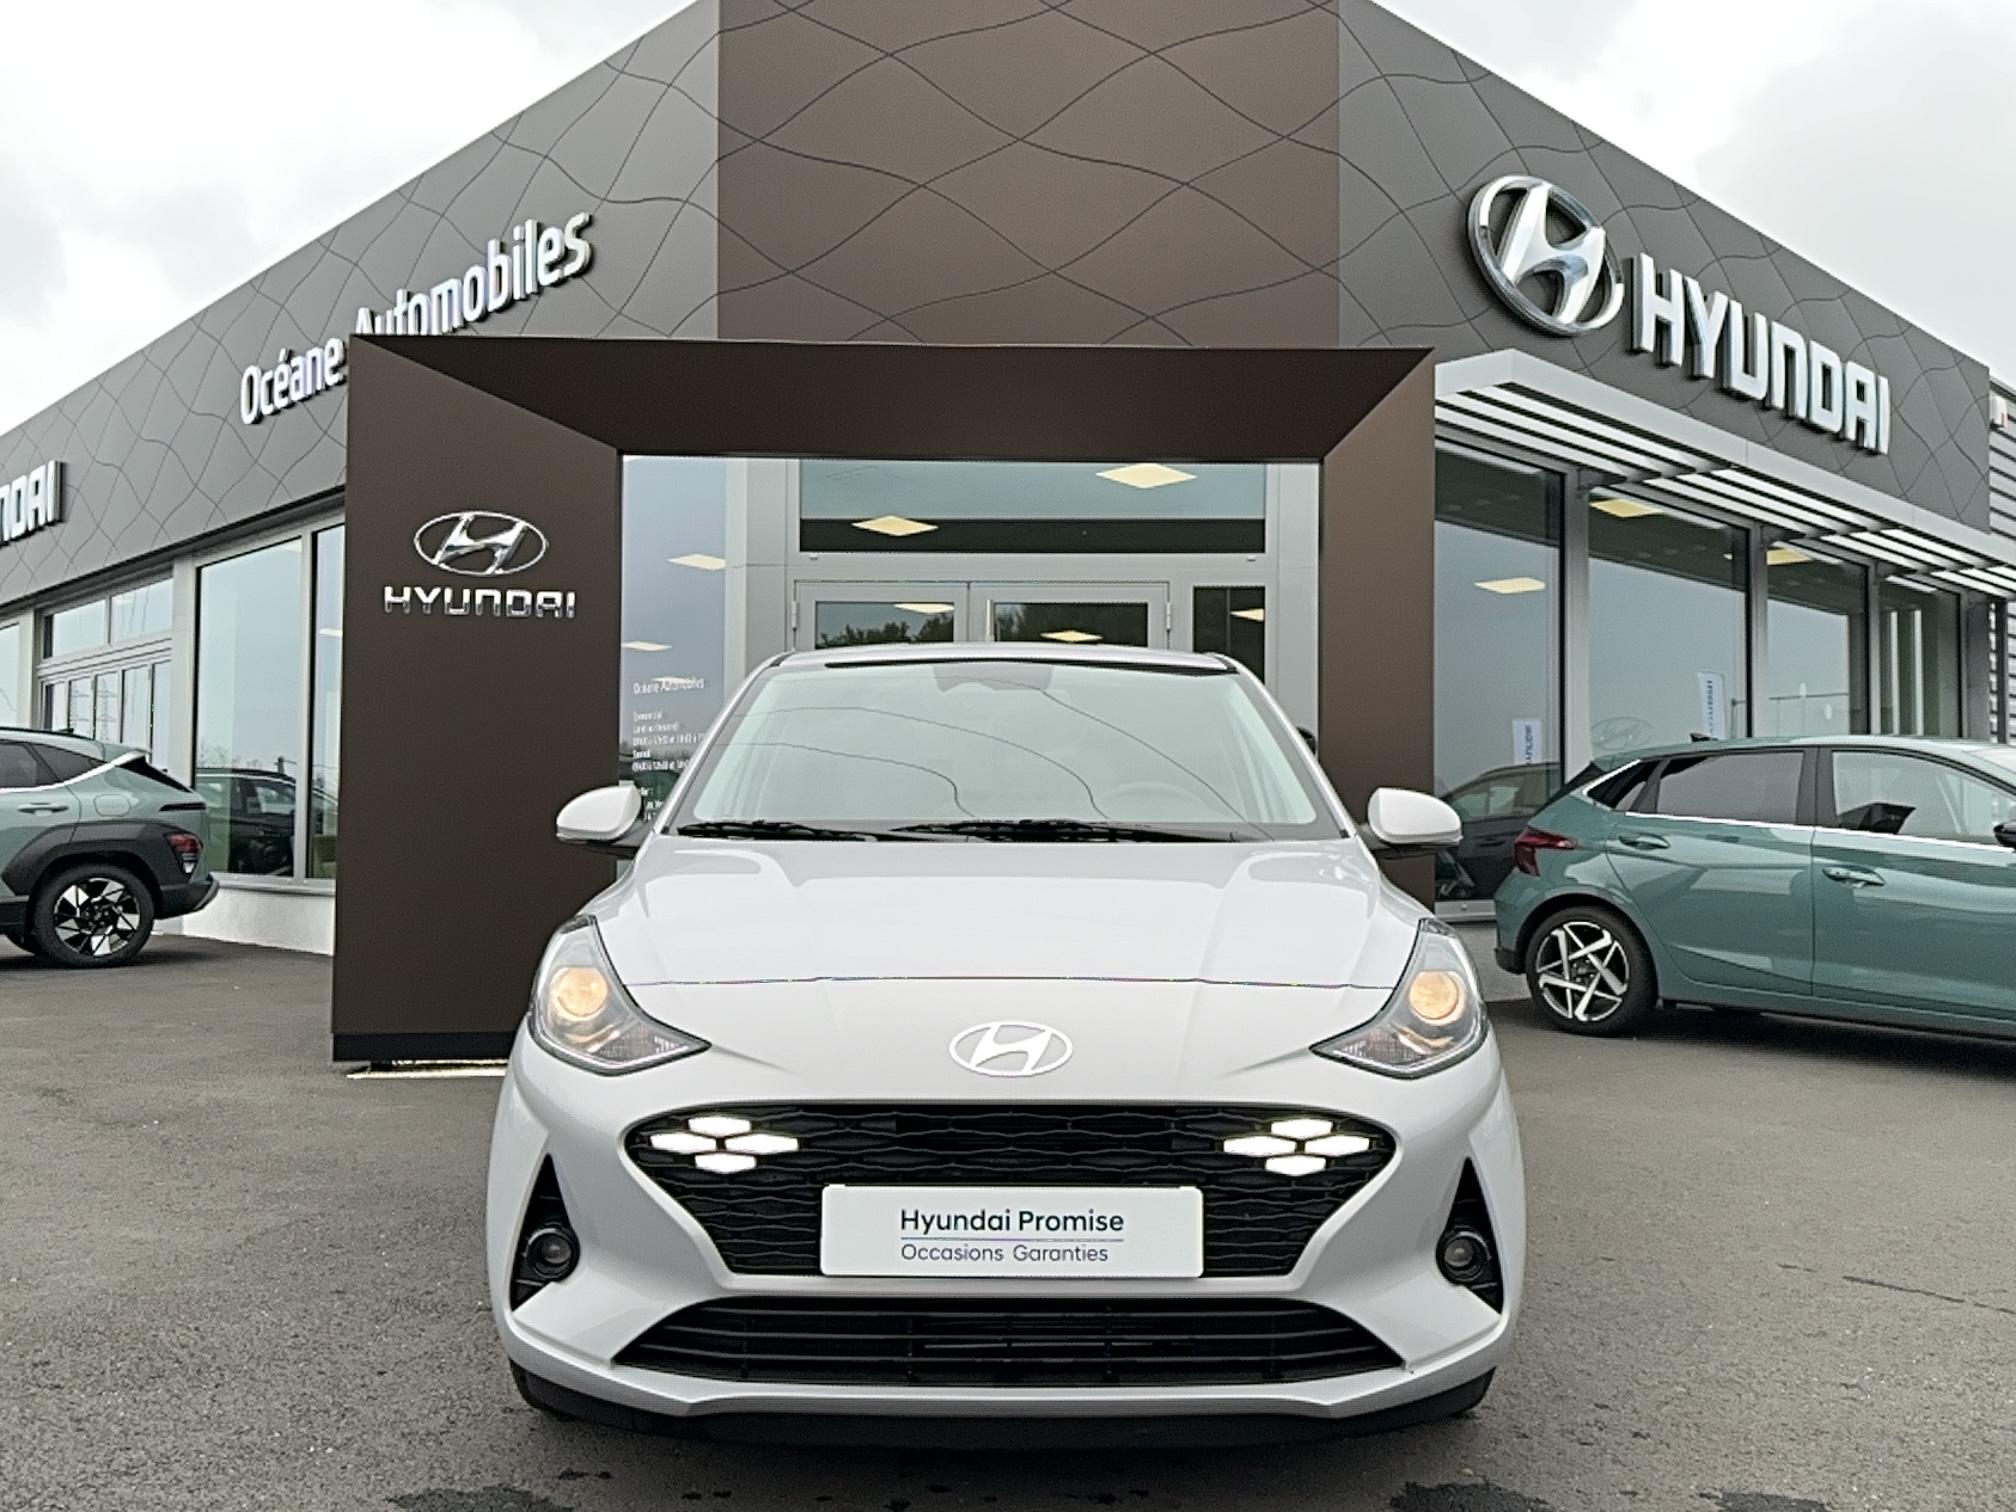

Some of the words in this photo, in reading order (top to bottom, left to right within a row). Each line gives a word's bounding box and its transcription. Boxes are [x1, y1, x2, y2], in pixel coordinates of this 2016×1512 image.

[1628, 251, 1890, 455] HYUNDAI
[240, 337, 346, 425] Océane
[384, 585, 576, 619] HYUNDAI
[900, 1208, 1011, 1235] Hyundai
[1018, 1209, 1125, 1233] Promise
[900, 1243, 1004, 1263] Occasions
[1012, 1244, 1109, 1263] Garanties
